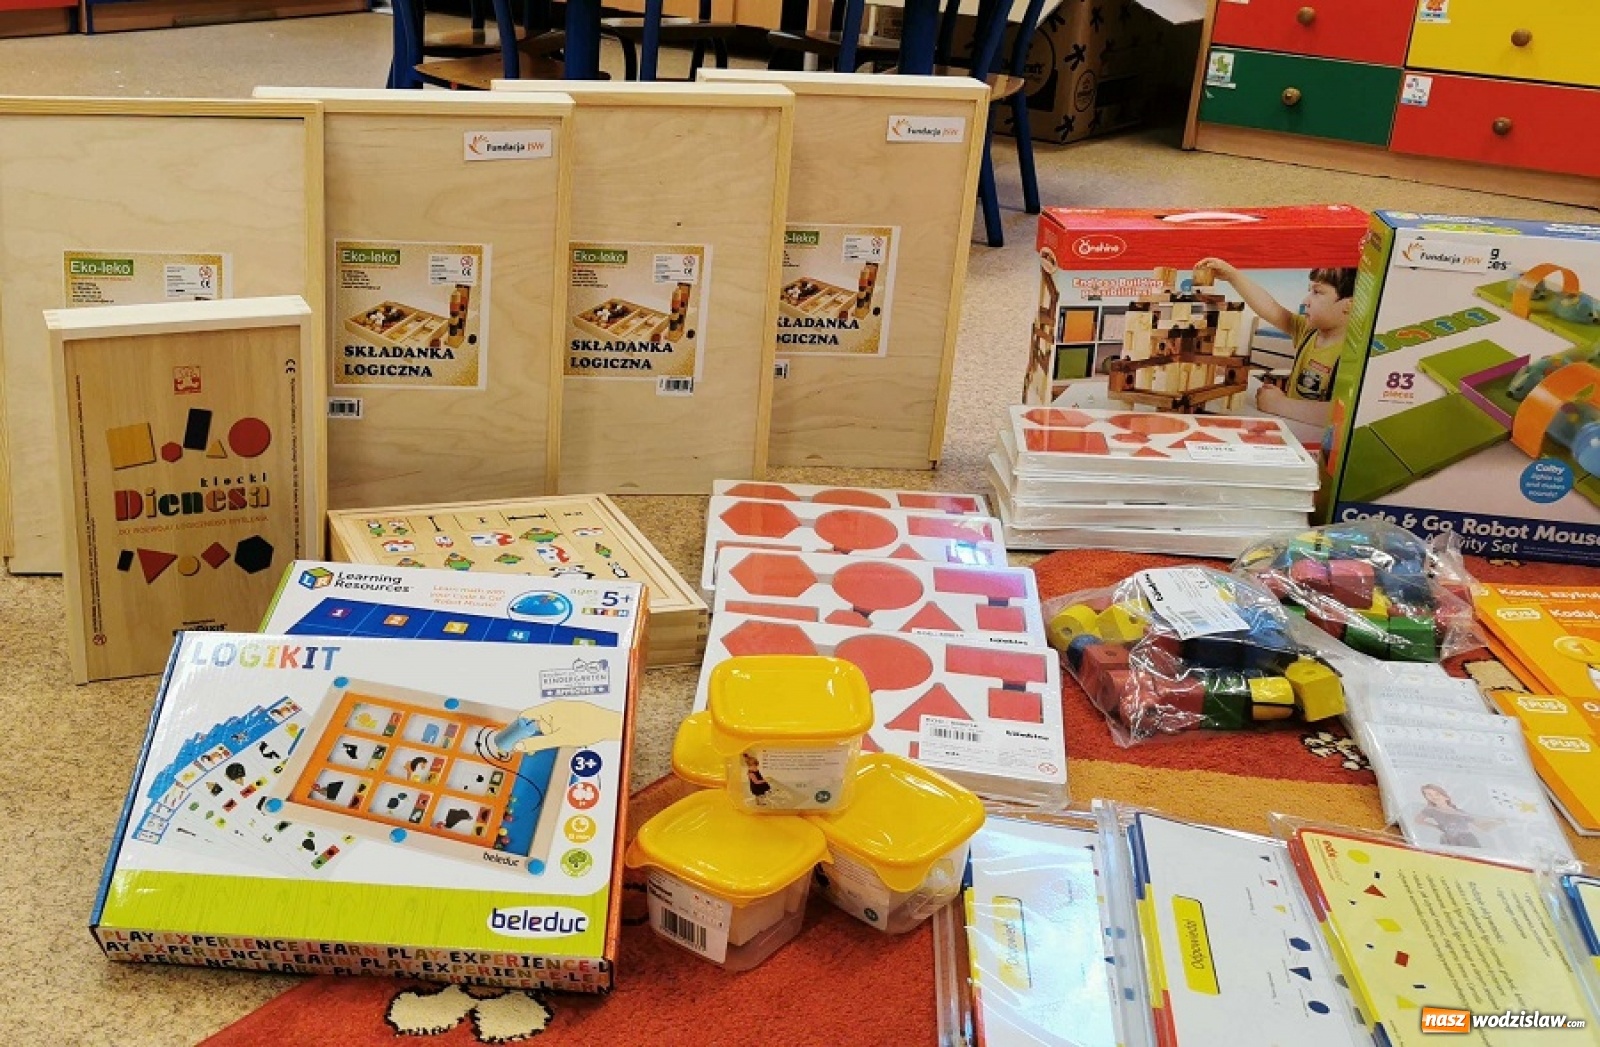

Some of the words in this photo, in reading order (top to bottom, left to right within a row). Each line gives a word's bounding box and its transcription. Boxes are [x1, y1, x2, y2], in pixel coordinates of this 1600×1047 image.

[487, 142, 525, 153] Fundacja
[342, 250, 397, 263] Eko-leko
[574, 251, 625, 263] Eko-leko
[1420, 252, 1460, 265] Fundacja
[71, 261, 131, 275] Eko-leko
[1120, 279, 1164, 289] Building
[344, 345, 454, 359] SKŁADANKA
[570, 340, 673, 352] SKŁADANKA
[570, 357, 652, 370] LOGICZNA
[344, 364, 432, 377] LOGICZNA
[1387, 373, 1415, 389] 83
[1536, 464, 1565, 475] Colby
[114, 486, 270, 521] Dienesa
[1402, 514, 1417, 528] &
[1422, 515, 1453, 531] Go
[1462, 518, 1529, 538] Robot
[1493, 540, 1518, 554] Set
[338, 571, 402, 585] Learning
[334, 580, 410, 593] Resources
[602, 591, 632, 607] 5+
[192, 641, 341, 671] LOGIKIT
[575, 757, 597, 770] 3+
[483, 852, 519, 867] beleduc
[491, 908, 586, 933] beleduc
